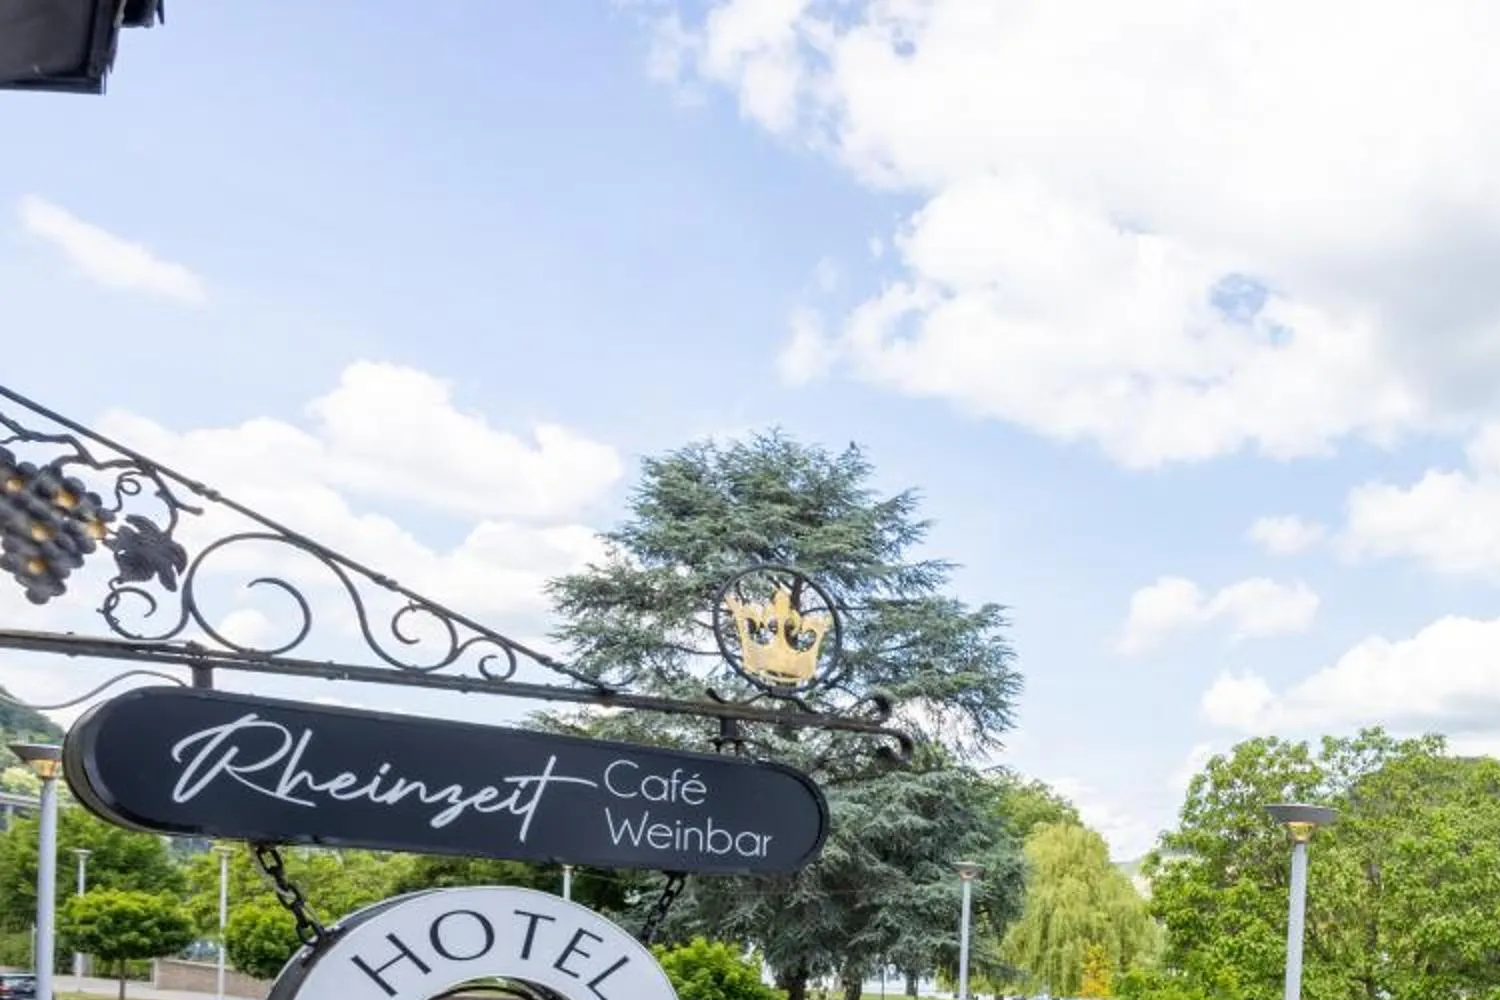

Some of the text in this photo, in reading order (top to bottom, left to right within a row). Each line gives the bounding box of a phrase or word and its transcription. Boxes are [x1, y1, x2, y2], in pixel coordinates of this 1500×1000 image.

[171, 713, 599, 843] Rheinzeit
[604, 759, 707, 805] Café
[605, 807, 773, 857] Weinbar
